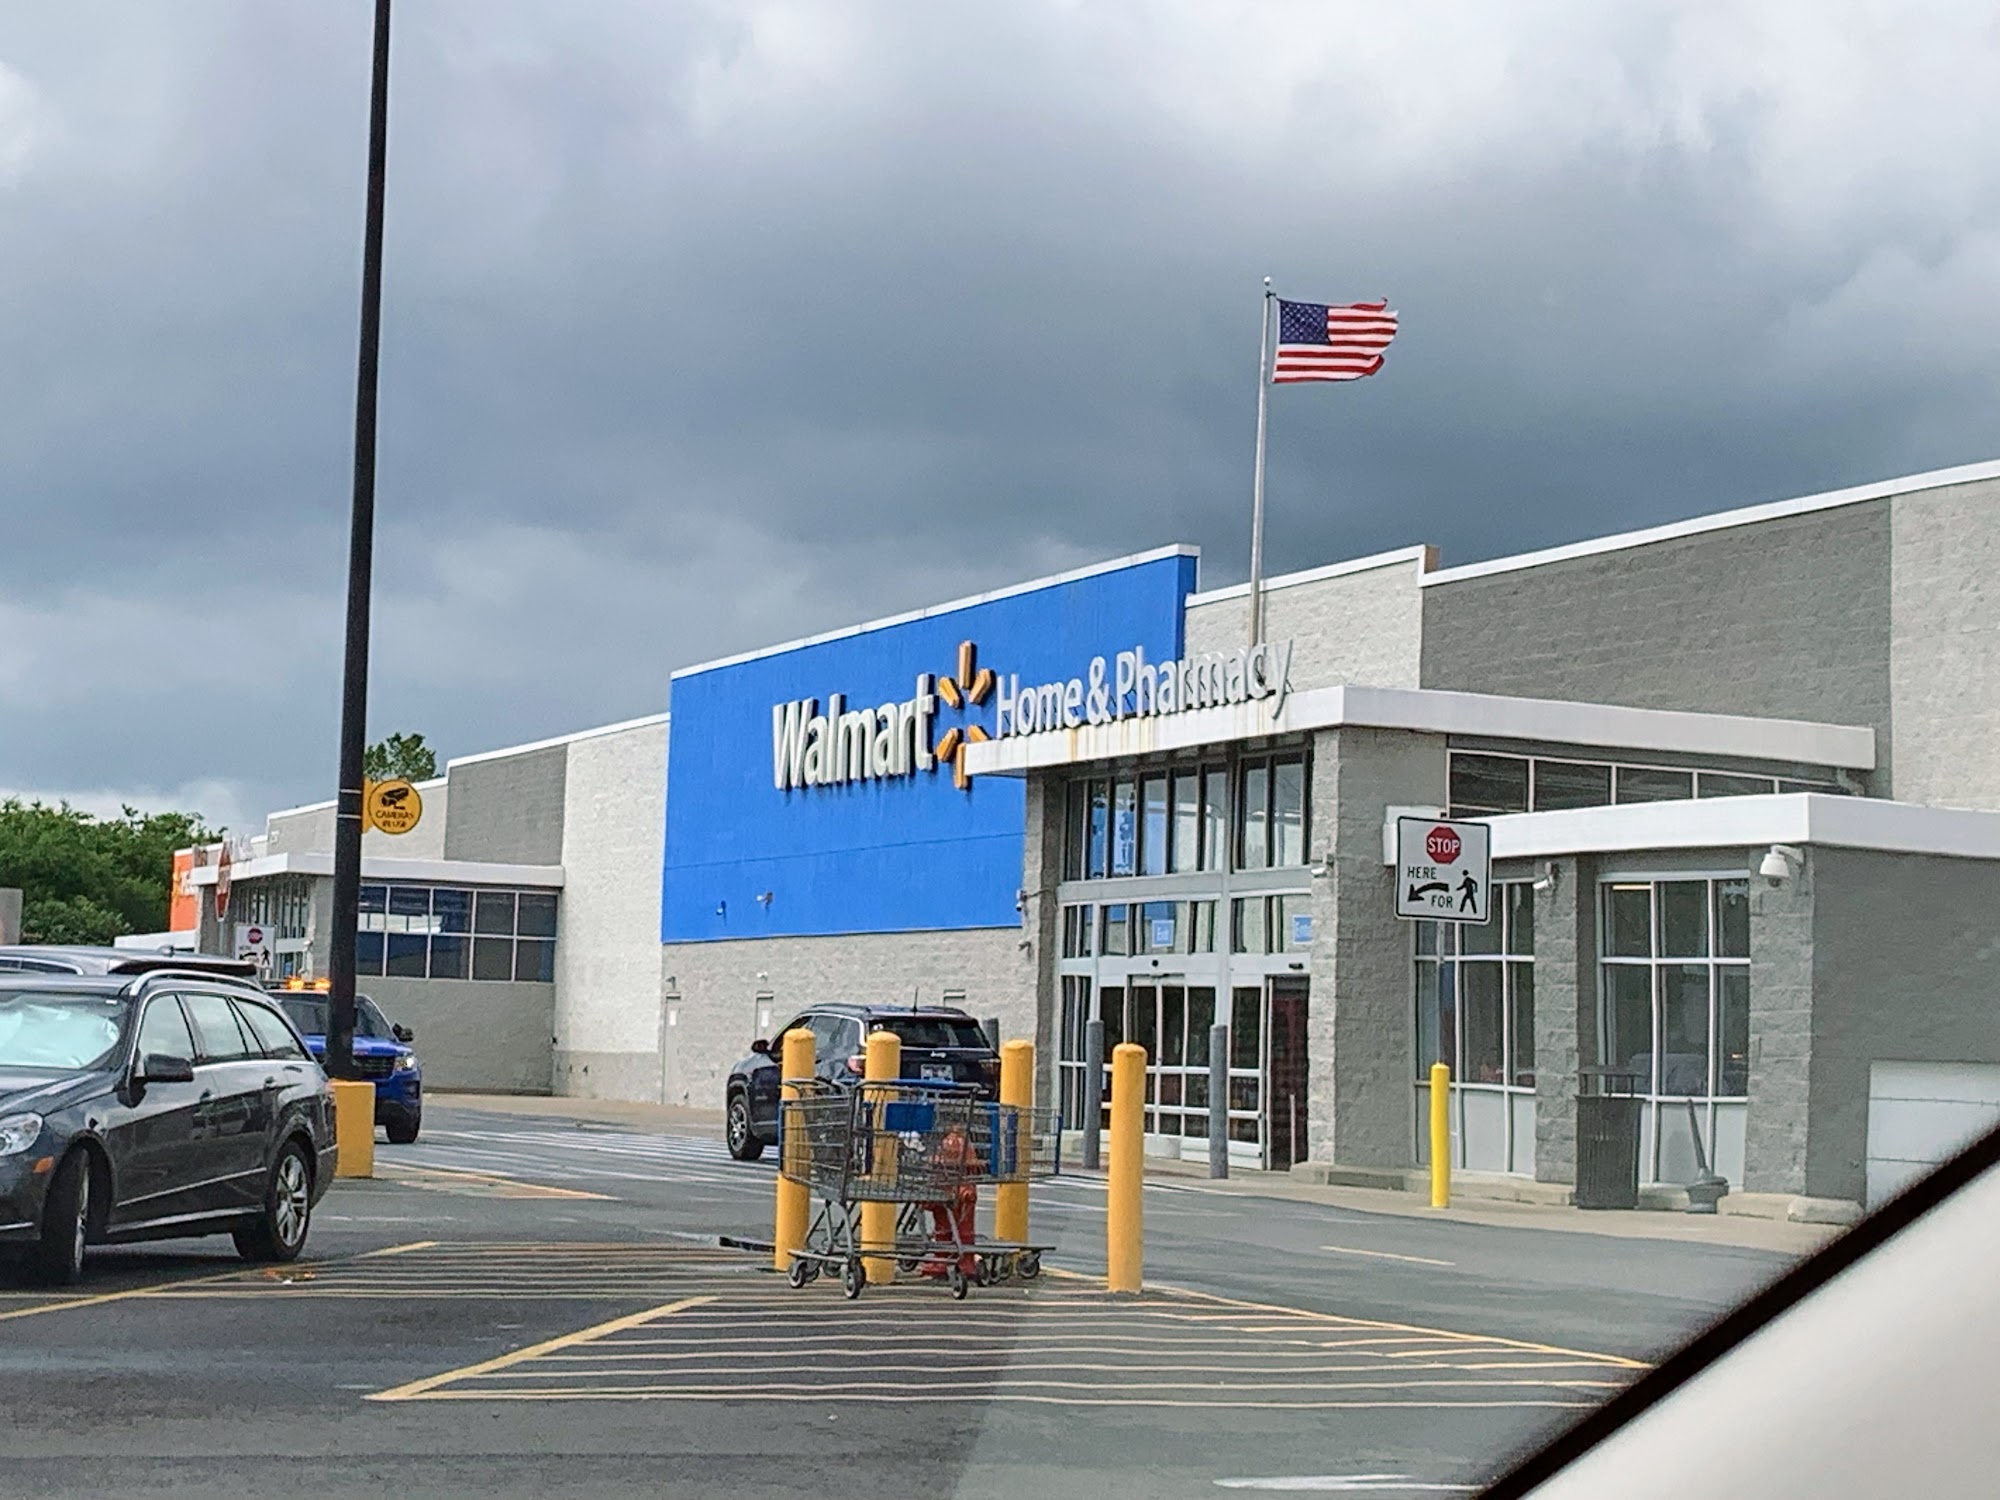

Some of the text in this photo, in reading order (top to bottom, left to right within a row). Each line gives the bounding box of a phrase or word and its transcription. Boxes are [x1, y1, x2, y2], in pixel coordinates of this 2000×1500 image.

[996, 638, 1293, 740] Home & Pharmacy
[772, 673, 934, 790] Walmart
[1427, 838, 1460, 854] STOP
[1407, 866, 1437, 879] HERE
[1430, 895, 1453, 908] FOR
